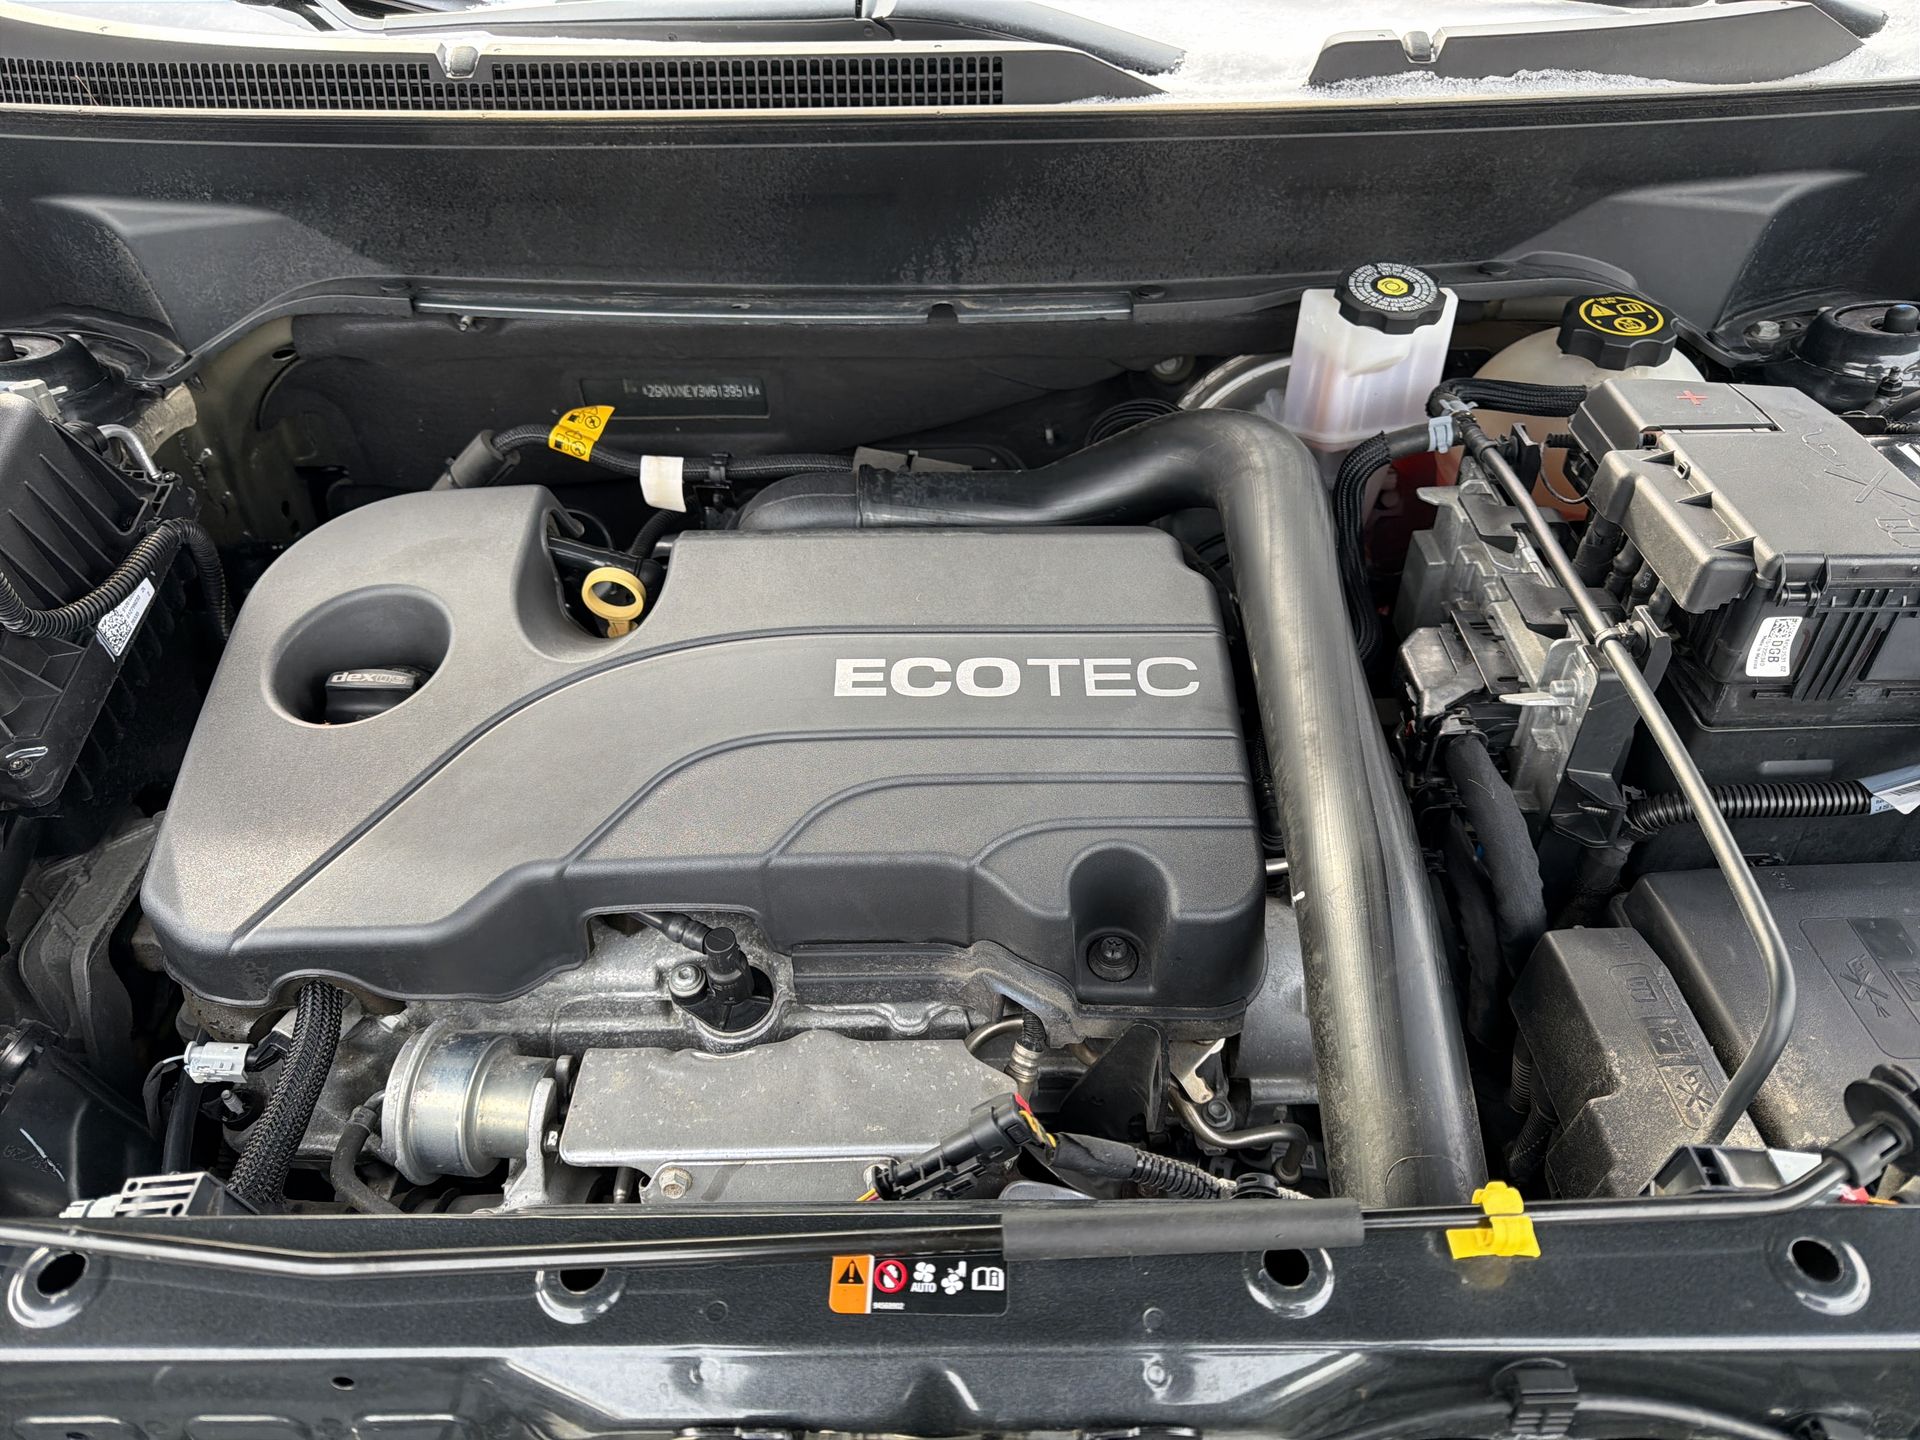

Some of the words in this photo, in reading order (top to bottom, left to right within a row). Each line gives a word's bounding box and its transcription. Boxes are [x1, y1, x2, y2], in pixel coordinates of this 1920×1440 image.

[1768, 640, 1783, 662] DGB
[330, 672, 408, 685] dexos
[833, 656, 1201, 698] ECOTEC
[910, 1282, 938, 1293] AUTO
